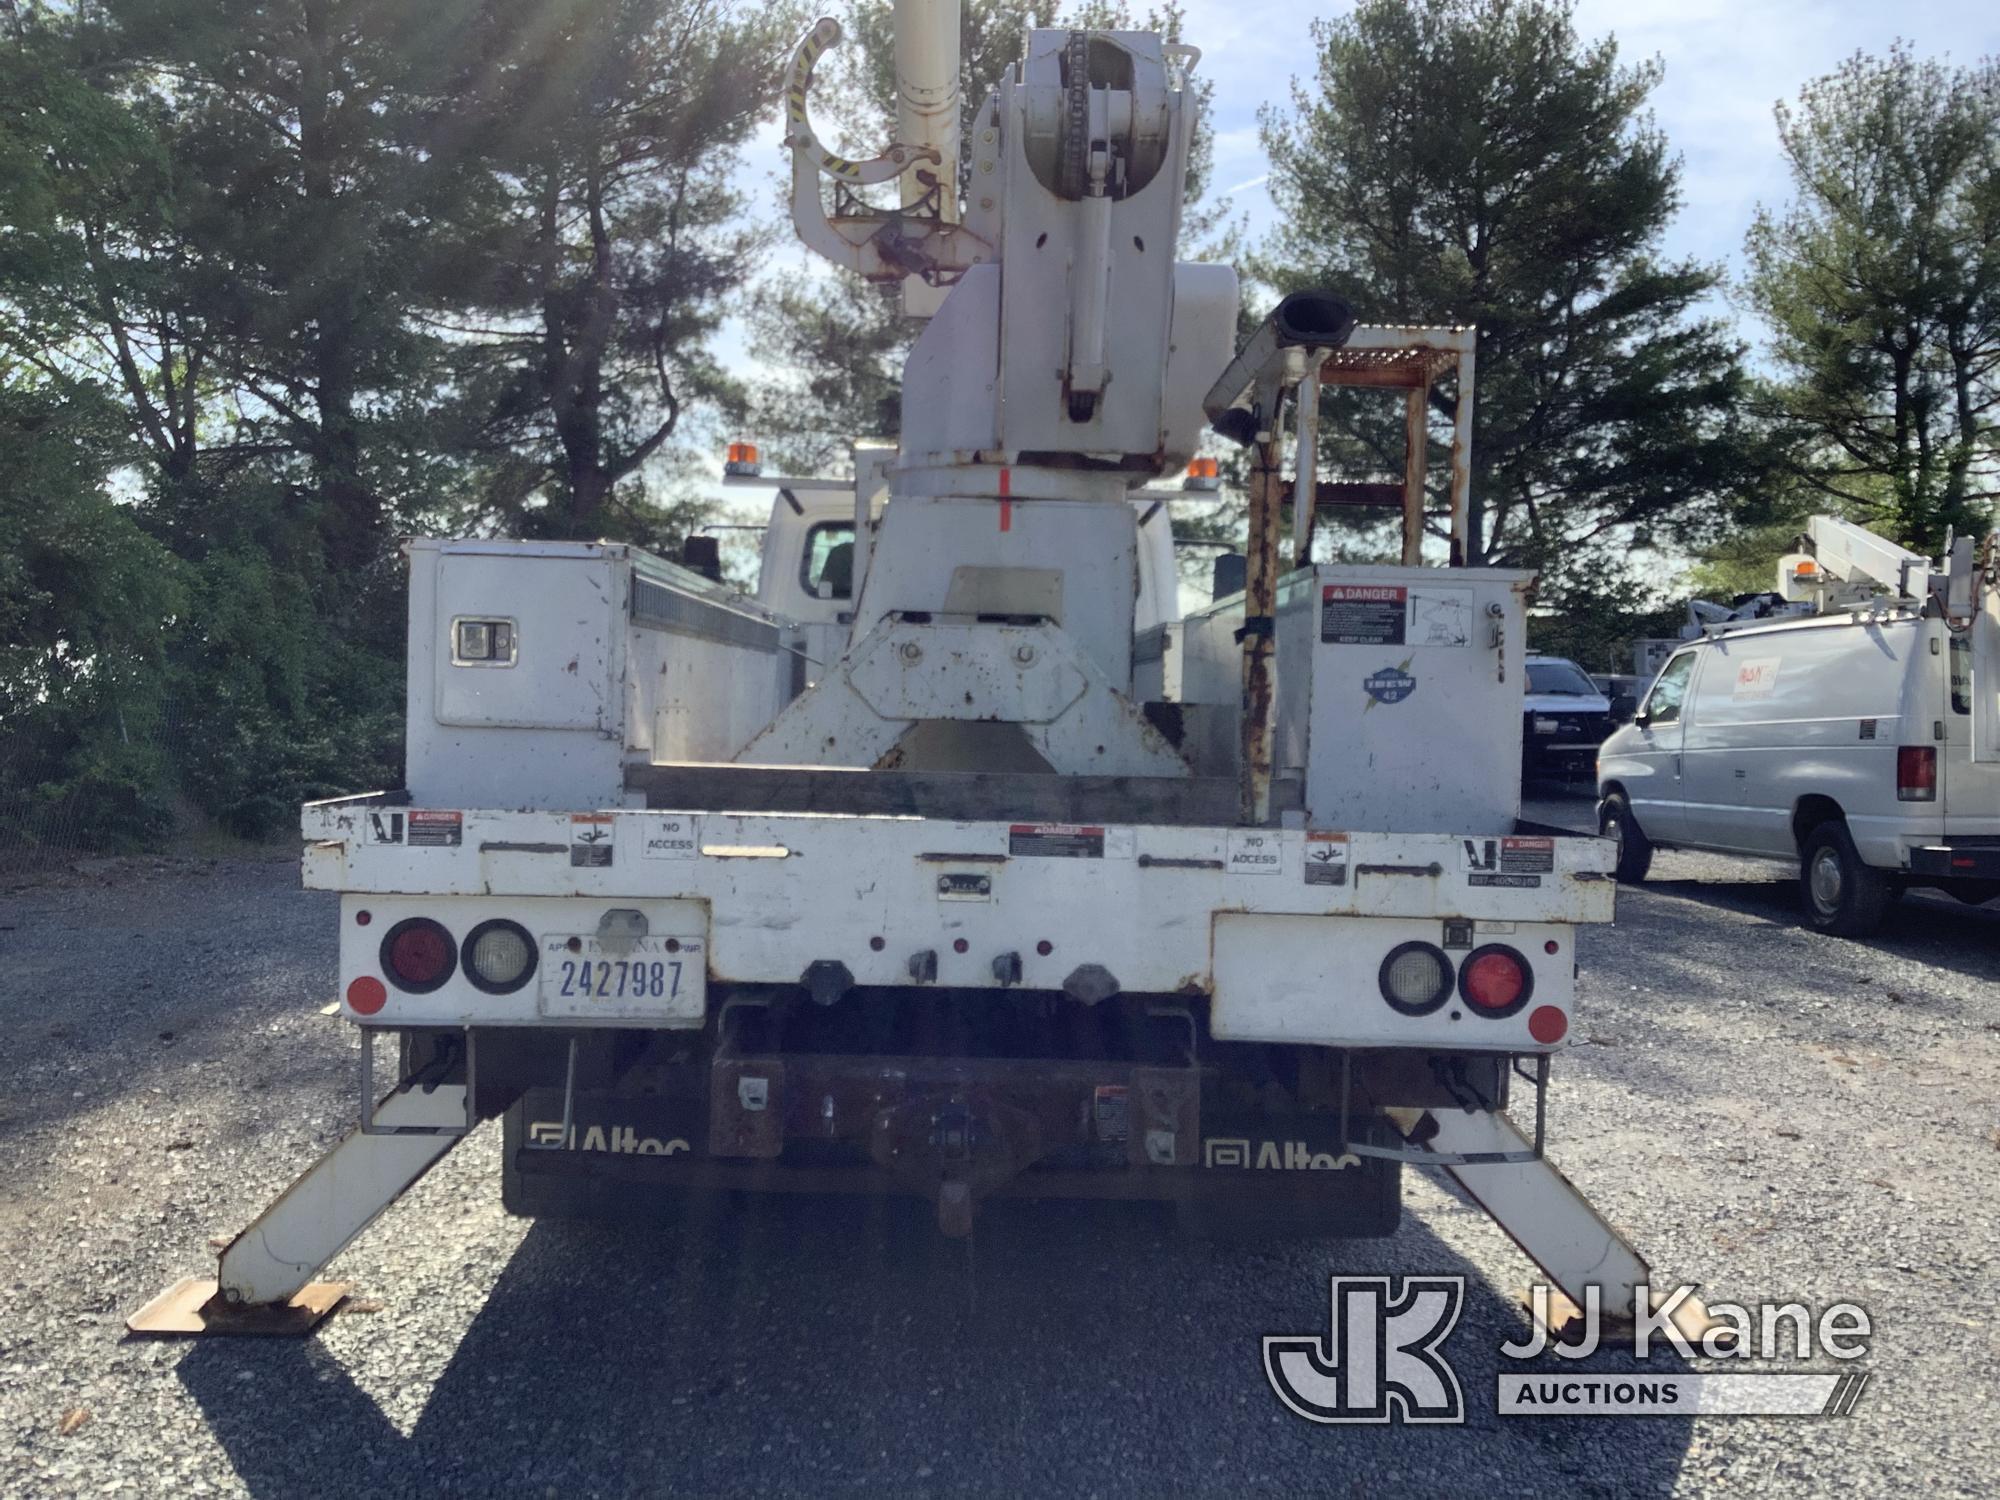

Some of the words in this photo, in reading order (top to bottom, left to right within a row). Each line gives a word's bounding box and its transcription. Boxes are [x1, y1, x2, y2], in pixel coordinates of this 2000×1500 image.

[1346, 588, 1397, 600] DANGER
[1339, 635, 1359, 643] KEEP
[1359, 636, 1384, 644] CLEAR
[662, 823, 680, 833] NO
[647, 839, 694, 850] ACCESS
[1246, 837, 1264, 848] NO
[1519, 840, 1551, 849] DANGER
[1231, 854, 1278, 865] ACCESS
[560, 960, 683, 998] 2427987
